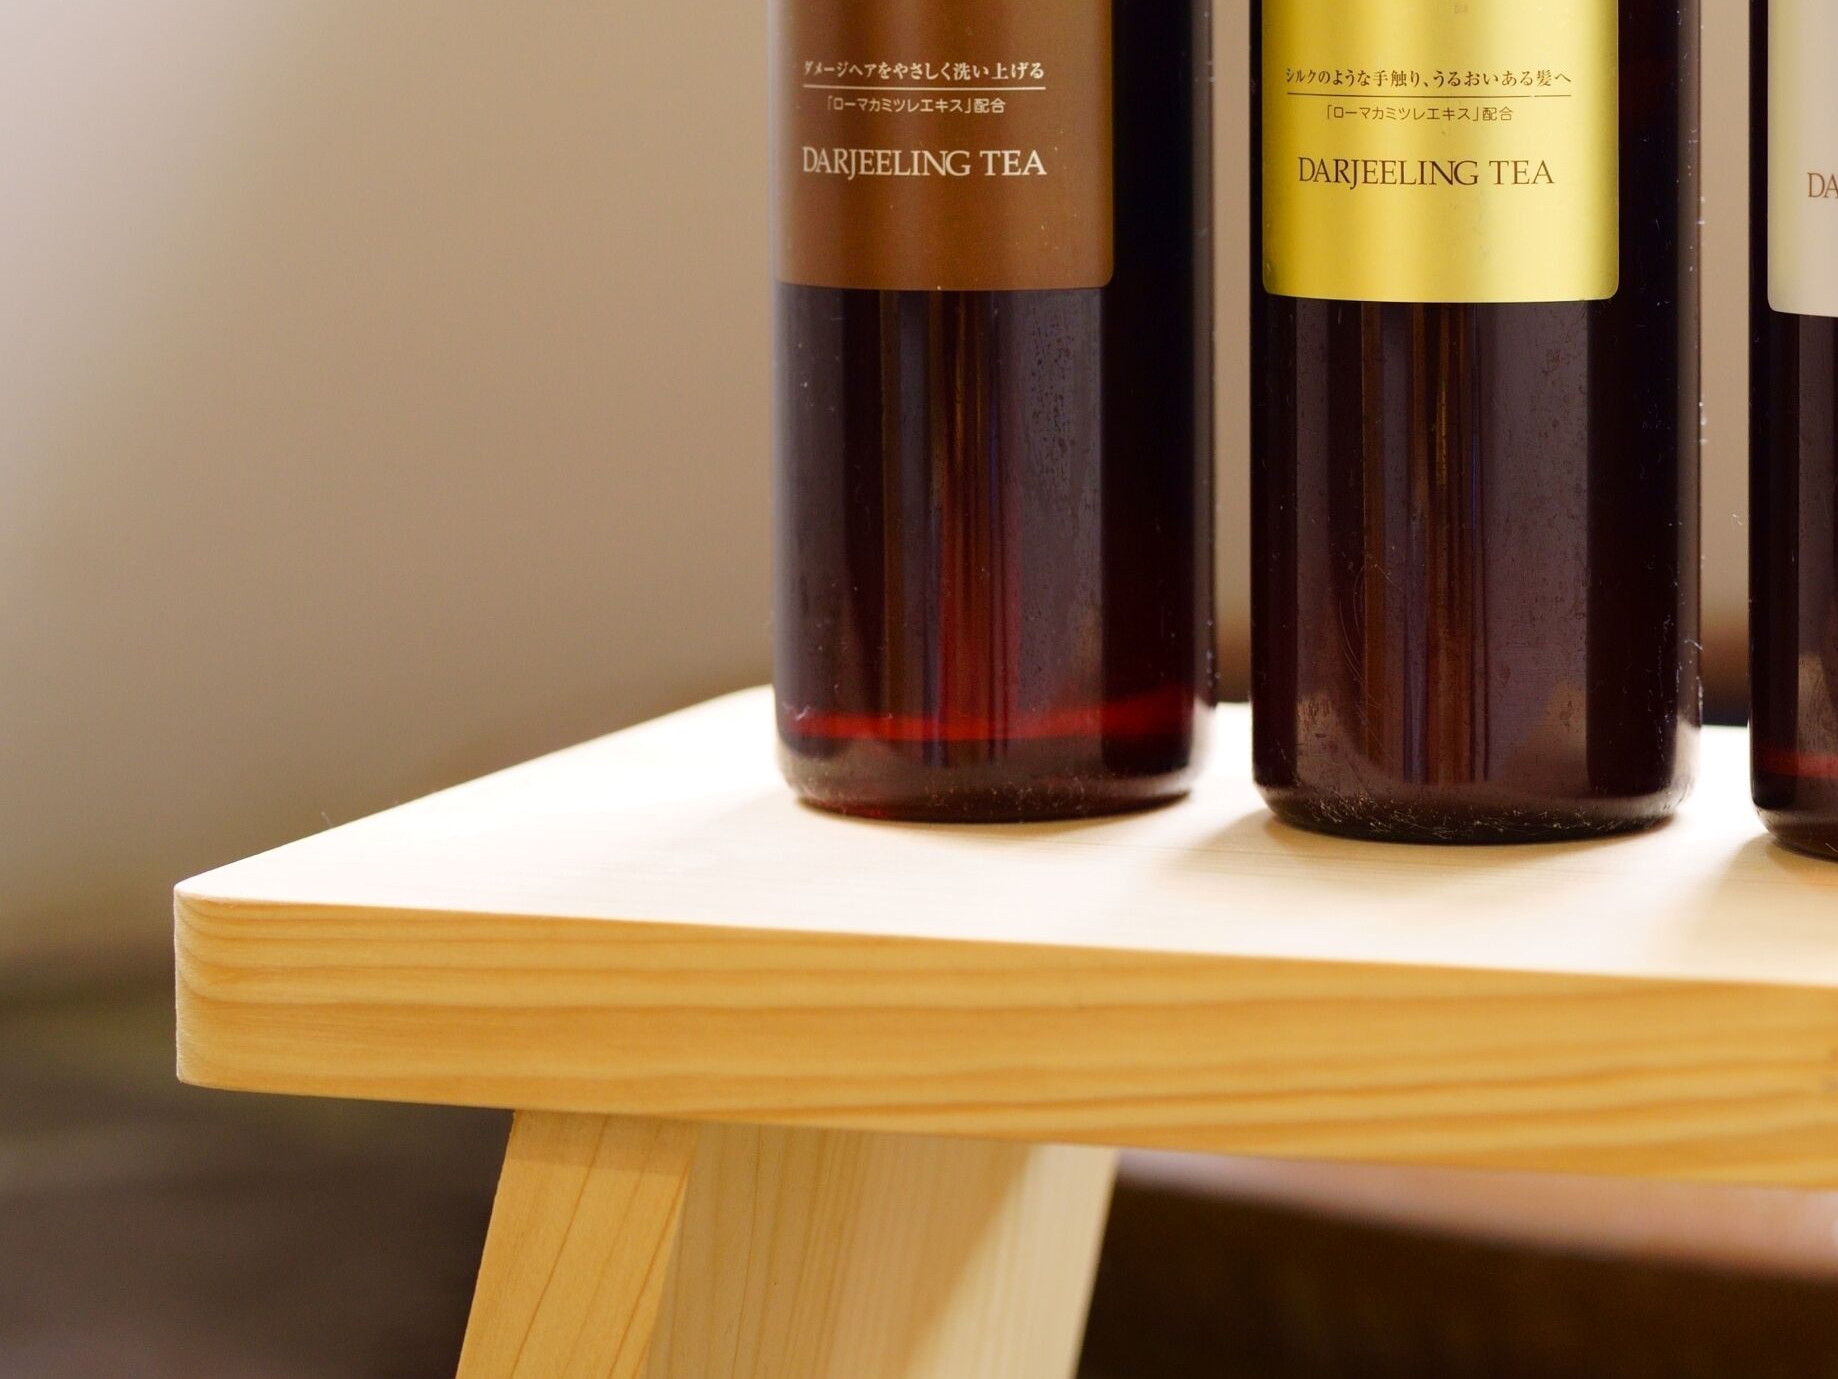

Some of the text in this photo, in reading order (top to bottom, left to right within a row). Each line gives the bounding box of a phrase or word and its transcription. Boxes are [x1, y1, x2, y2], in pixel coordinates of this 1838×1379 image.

[826, 96, 1007, 114] 「ローマカミツレエキス」配合
[1326, 104, 1514, 122] 「ローマカミツレエキス」配合
[801, 146, 1048, 181] DARJEELING TEA
[1298, 157, 1555, 190] DARJEELING TEA
